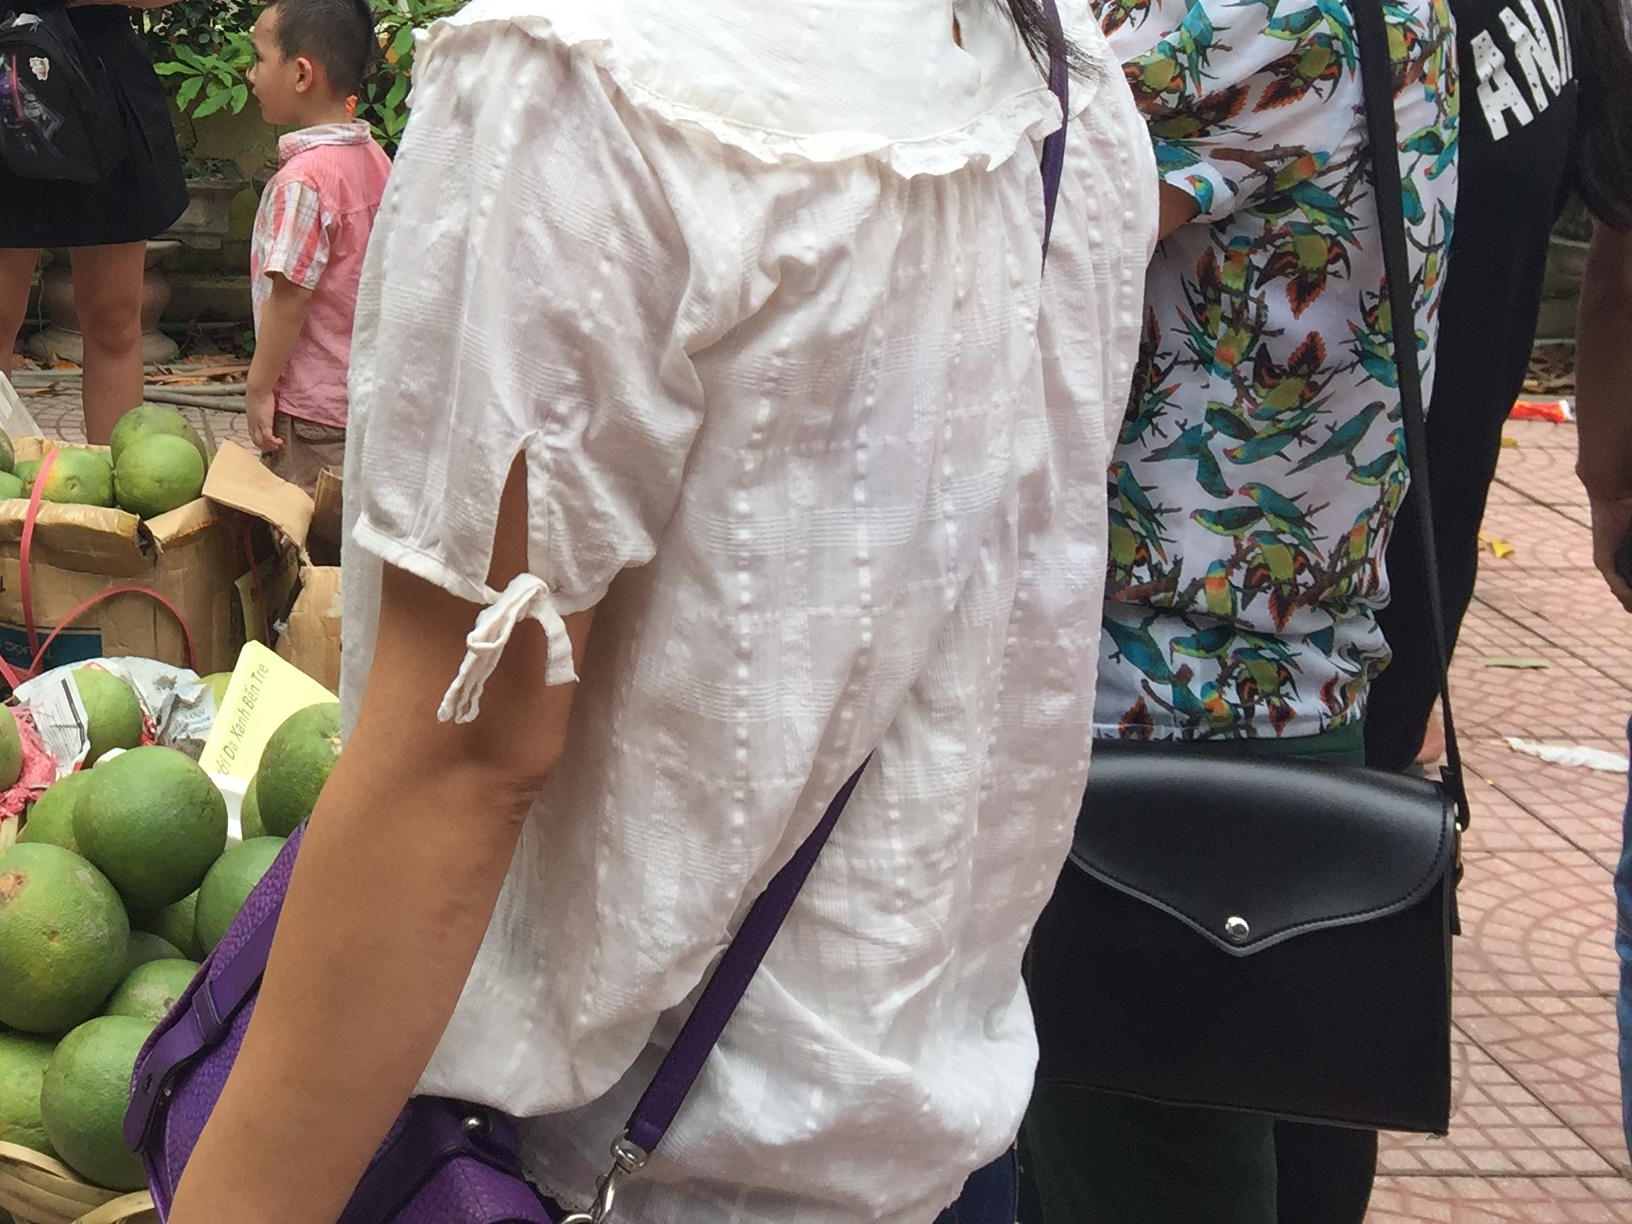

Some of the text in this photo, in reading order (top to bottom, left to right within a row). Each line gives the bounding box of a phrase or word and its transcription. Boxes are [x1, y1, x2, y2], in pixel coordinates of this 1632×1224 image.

[230, 707, 251, 742] Xanh
[241, 684, 261, 710] Bến
[251, 663, 269, 684] Tre
